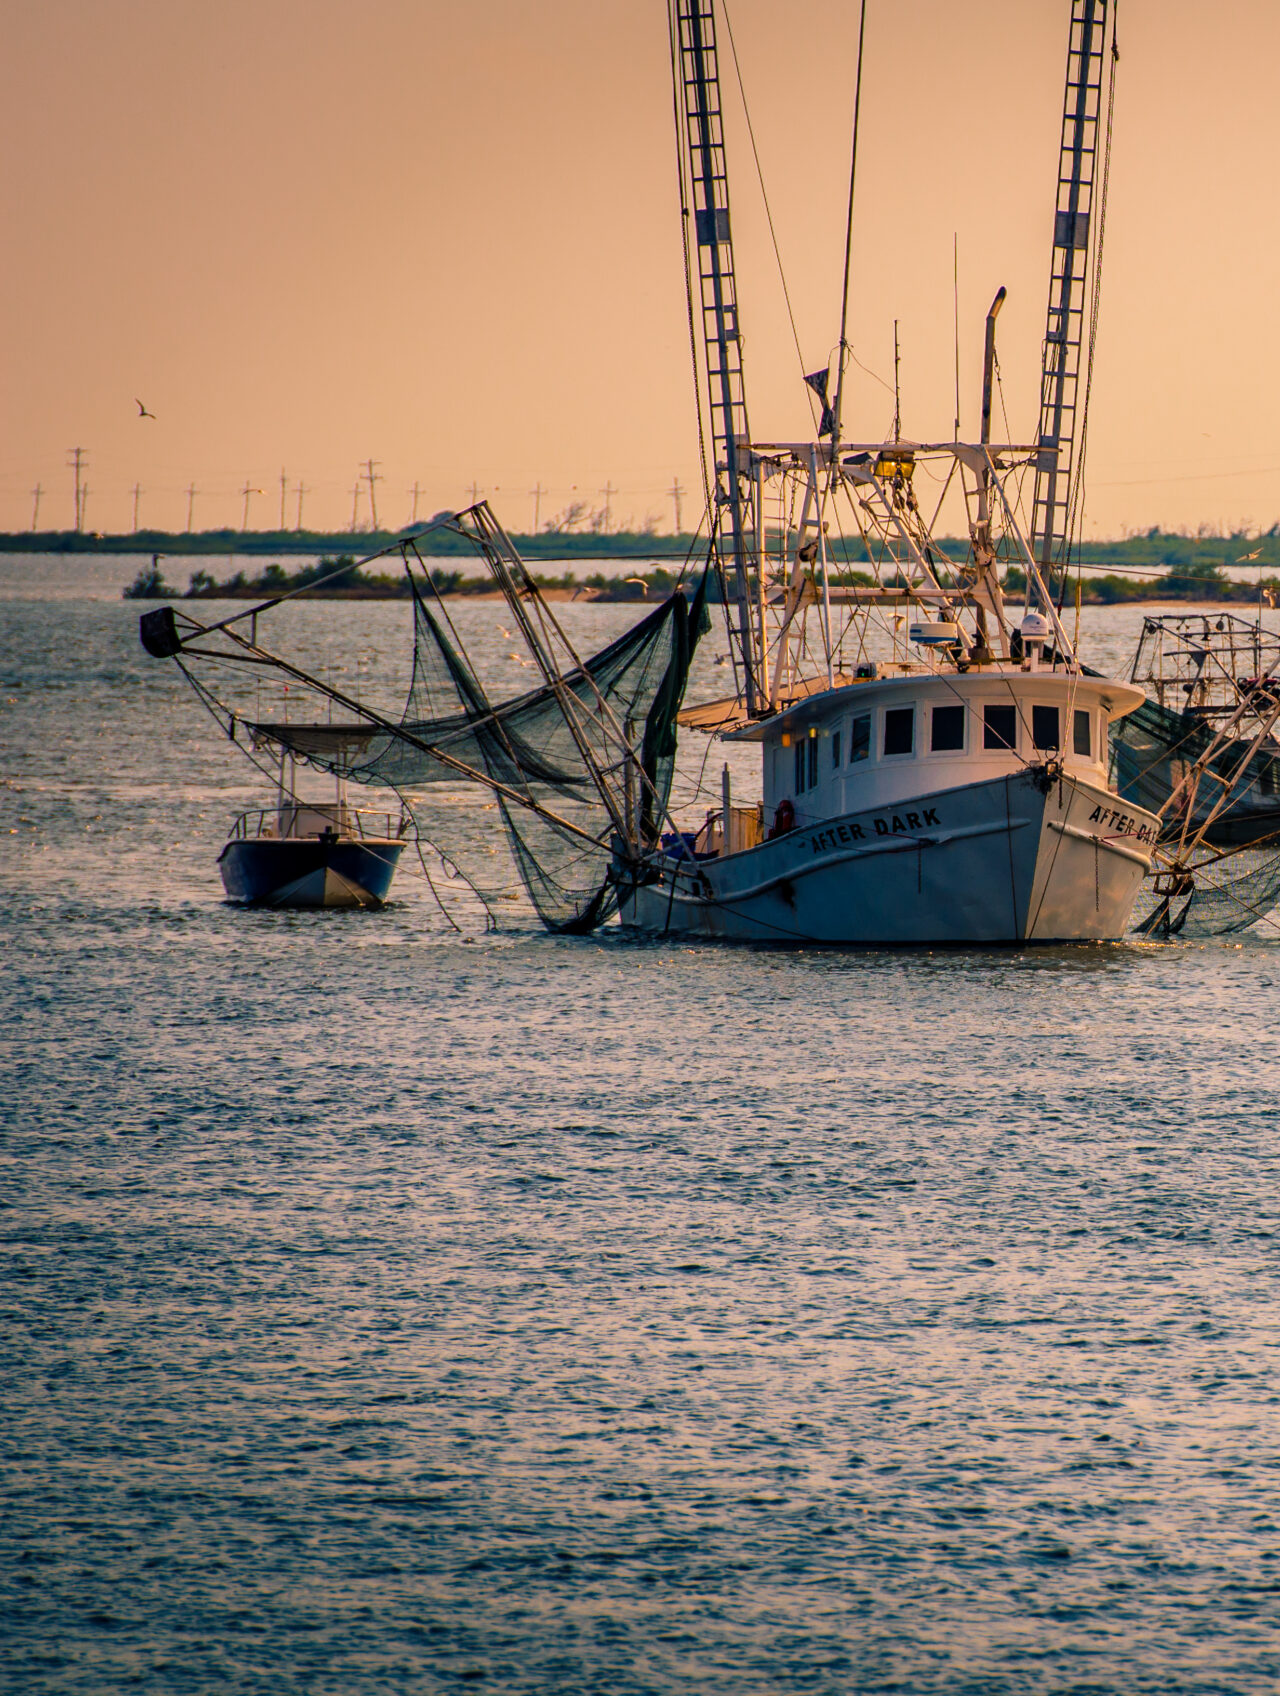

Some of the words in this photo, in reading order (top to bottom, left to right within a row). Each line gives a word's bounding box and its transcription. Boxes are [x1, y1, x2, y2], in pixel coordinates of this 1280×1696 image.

[811, 823, 866, 854] AFTER
[873, 808, 941, 835] DARK
[1088, 805, 1135, 836] AFTER
